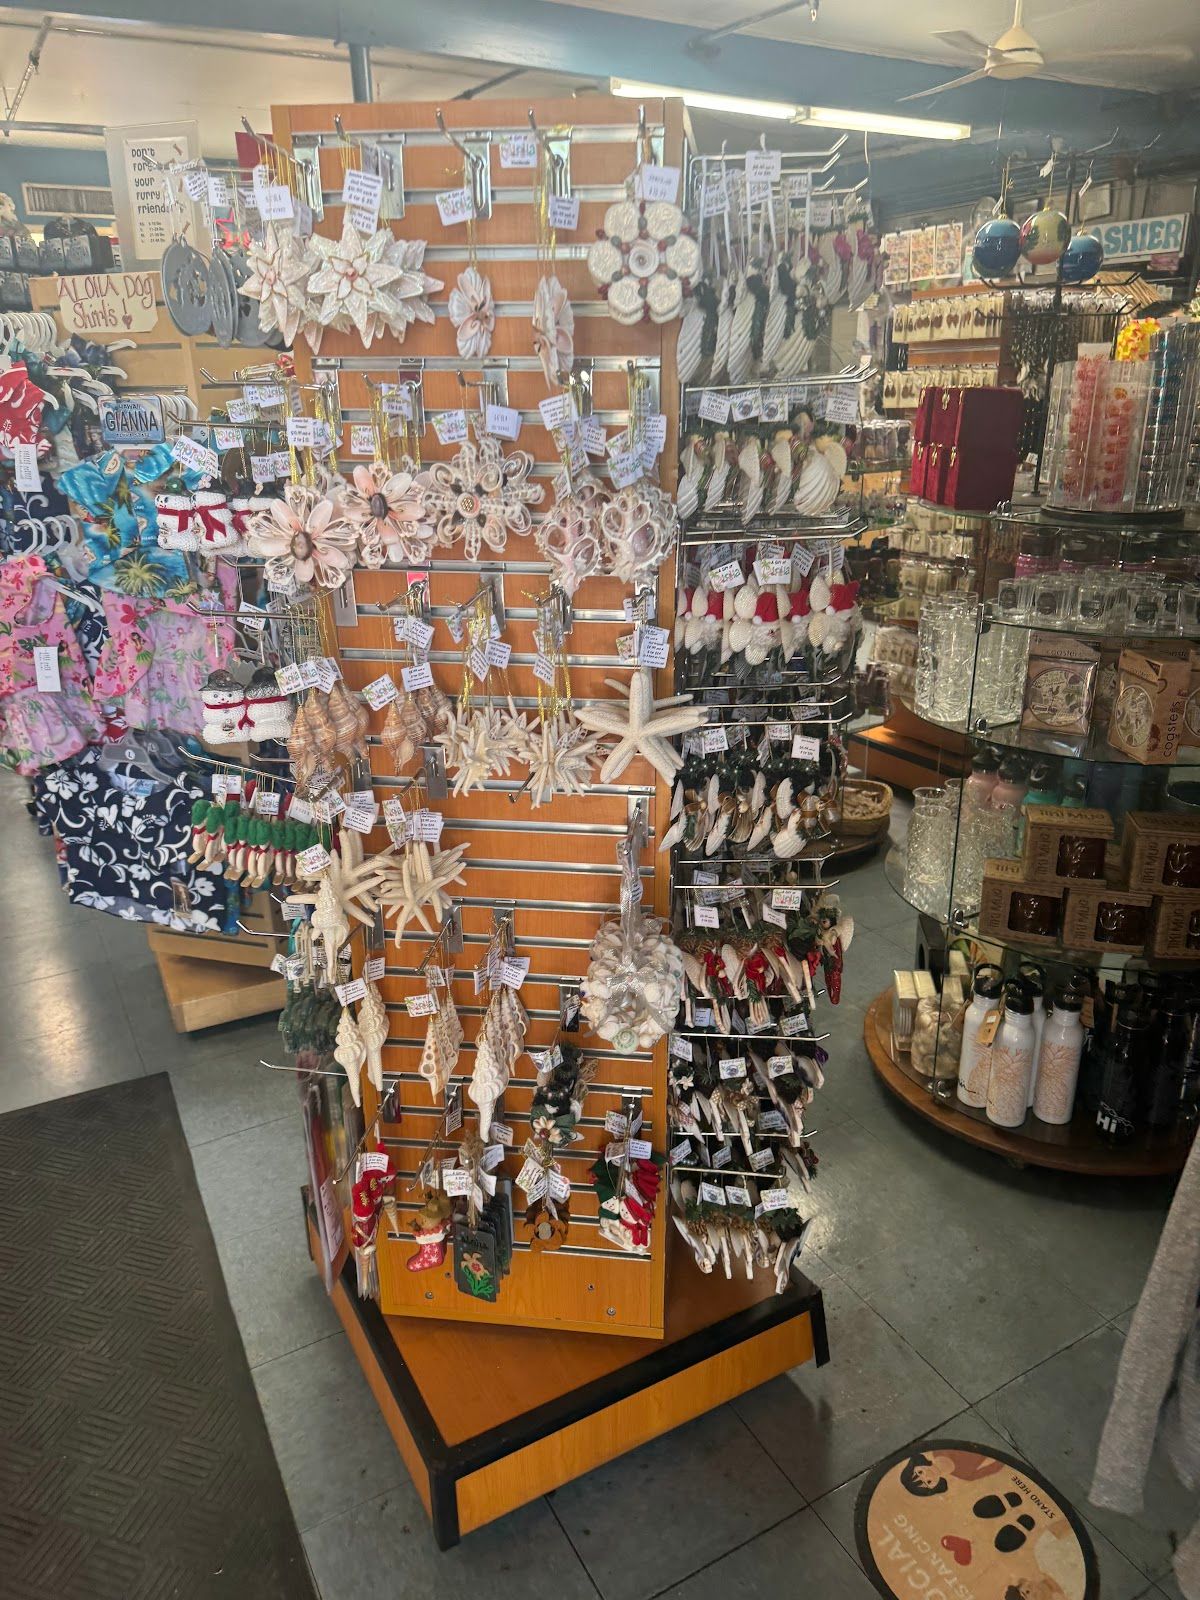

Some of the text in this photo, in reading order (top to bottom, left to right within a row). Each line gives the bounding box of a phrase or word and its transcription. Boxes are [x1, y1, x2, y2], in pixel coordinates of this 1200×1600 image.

[1091, 218, 1183, 256] SHIER
[105, 410, 159, 432] GIANNA
[1163, 701, 1181, 757] coasters
[1096, 1110, 1118, 1133] Hi
[1009, 1475, 1056, 1520] STAND HERE
[877, 1523, 948, 1600] OCIAL
